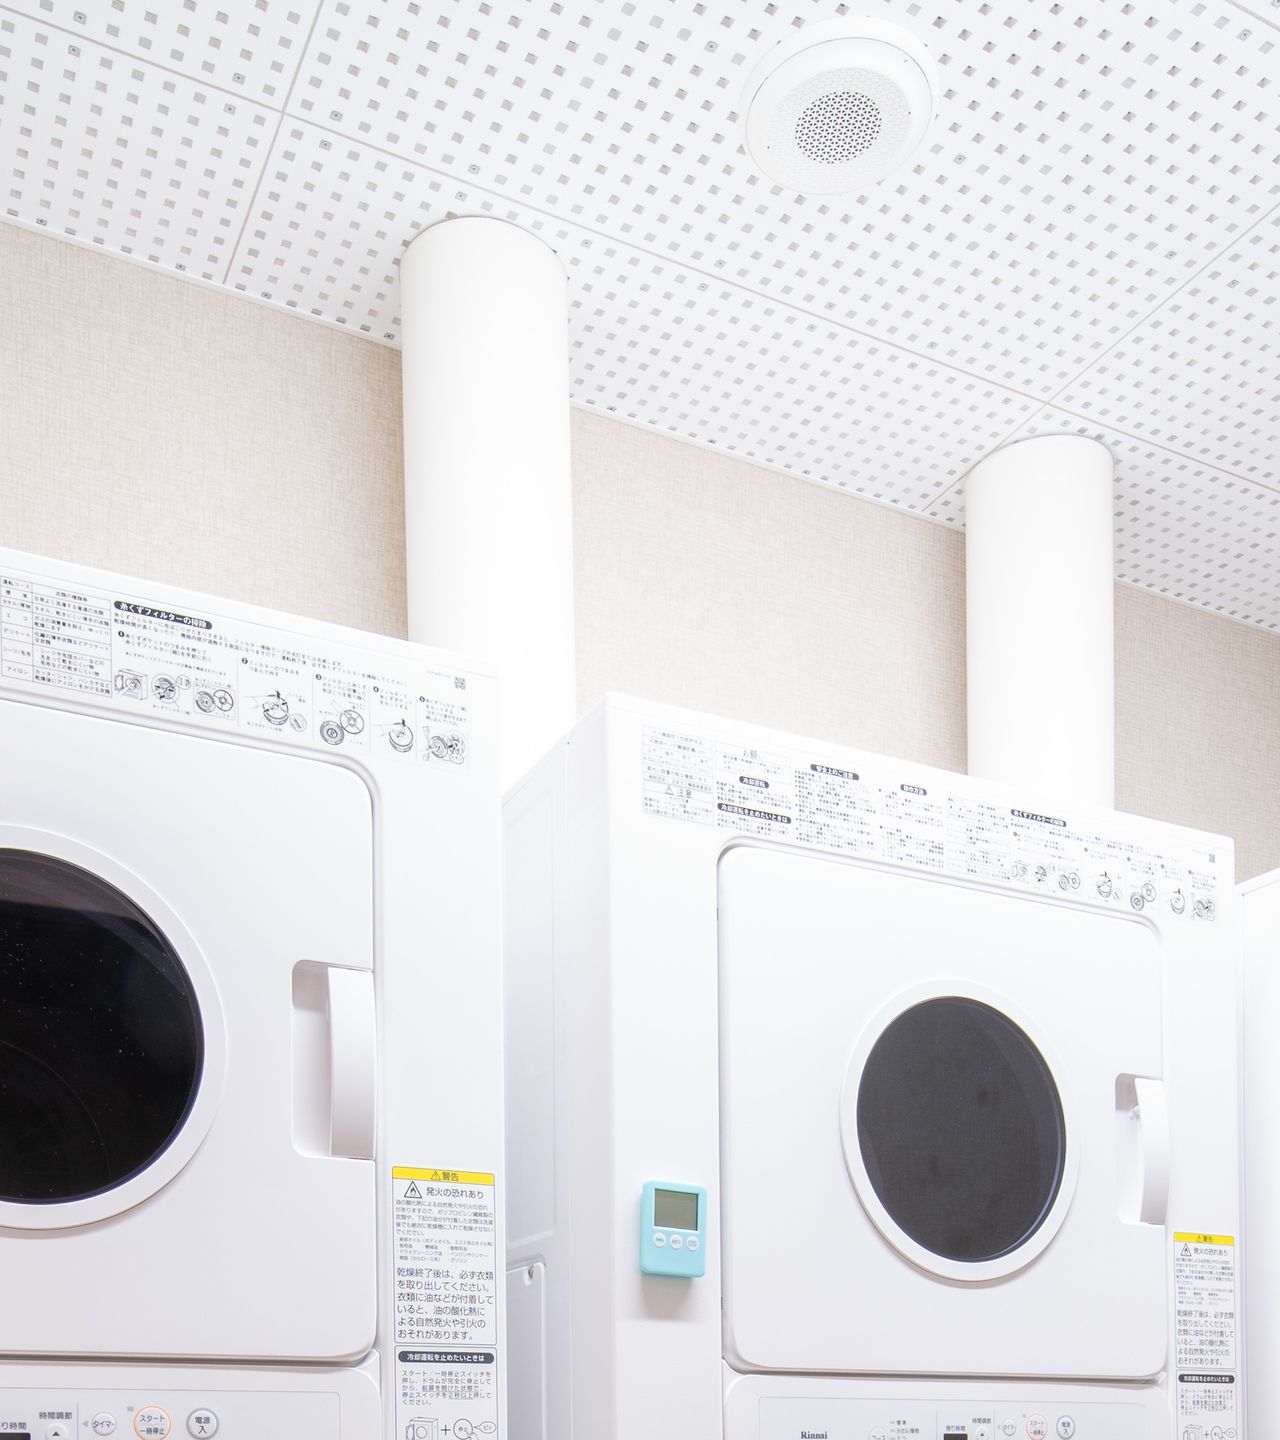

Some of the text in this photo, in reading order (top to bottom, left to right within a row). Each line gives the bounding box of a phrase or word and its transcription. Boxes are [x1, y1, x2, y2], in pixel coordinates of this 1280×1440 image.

[119, 602, 206, 629] 糸くずフィルターの掃除
[443, 1172, 459, 1182] 警告
[427, 1187, 484, 1199] 発火の恐れあり
[397, 1268, 494, 1280] 乾燥終了後は、必ず衣類
[397, 1280, 488, 1292] を取り出してください。
[397, 1293, 493, 1304] 衣類に油などが付着して
[397, 1305, 485, 1316] いると、油の酸化熱に
[398, 1317, 486, 1328] よる自然発火や引火の
[398, 1329, 472, 1340] おそれがあります。
[39, 1412, 72, 1420] 時間調節
[195, 1417, 210, 1425] 電源
[140, 1427, 165, 1435] 一時停止
[198, 1426, 207, 1434] 入
[801, 1431, 828, 1440] Rinnai
